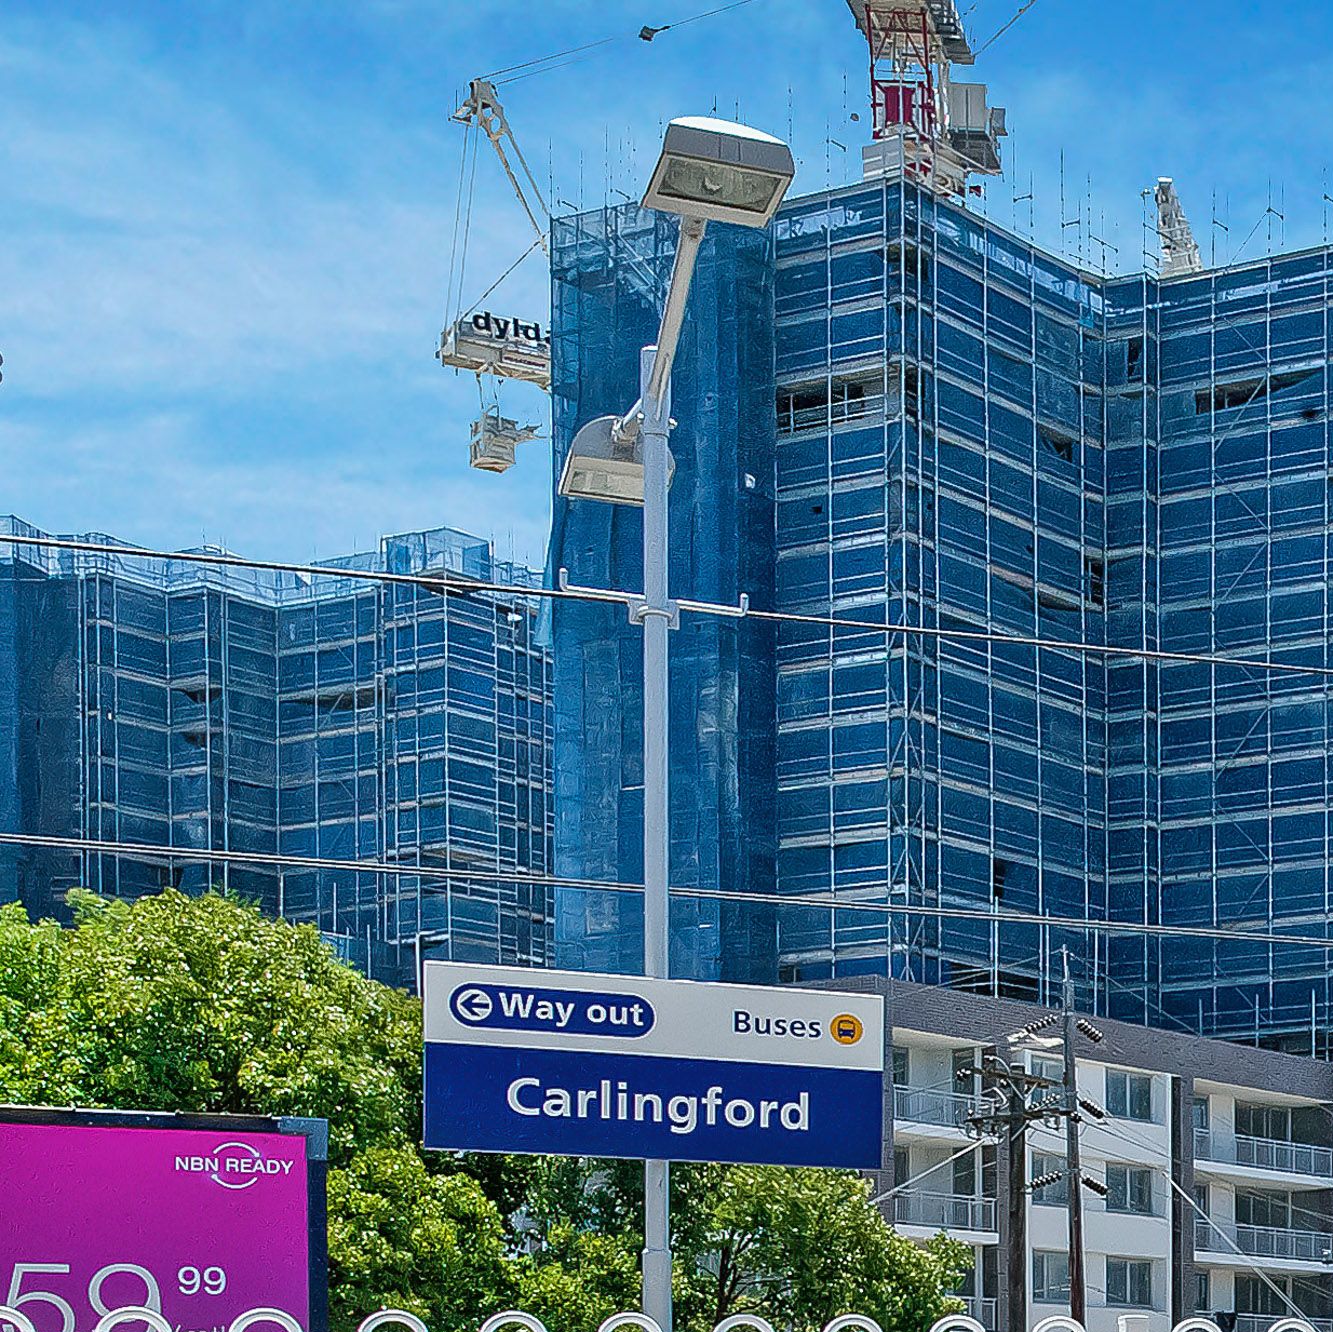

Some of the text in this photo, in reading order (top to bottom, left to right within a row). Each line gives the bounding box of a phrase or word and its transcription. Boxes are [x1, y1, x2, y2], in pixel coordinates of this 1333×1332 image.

[473, 311, 550, 344] dyld
[498, 992, 645, 1027] Way out
[732, 1010, 822, 1039] Buses
[506, 1076, 810, 1135] Carlingford
[175, 1156, 294, 1175] NBN READY
[177, 1266, 227, 1295] 99
